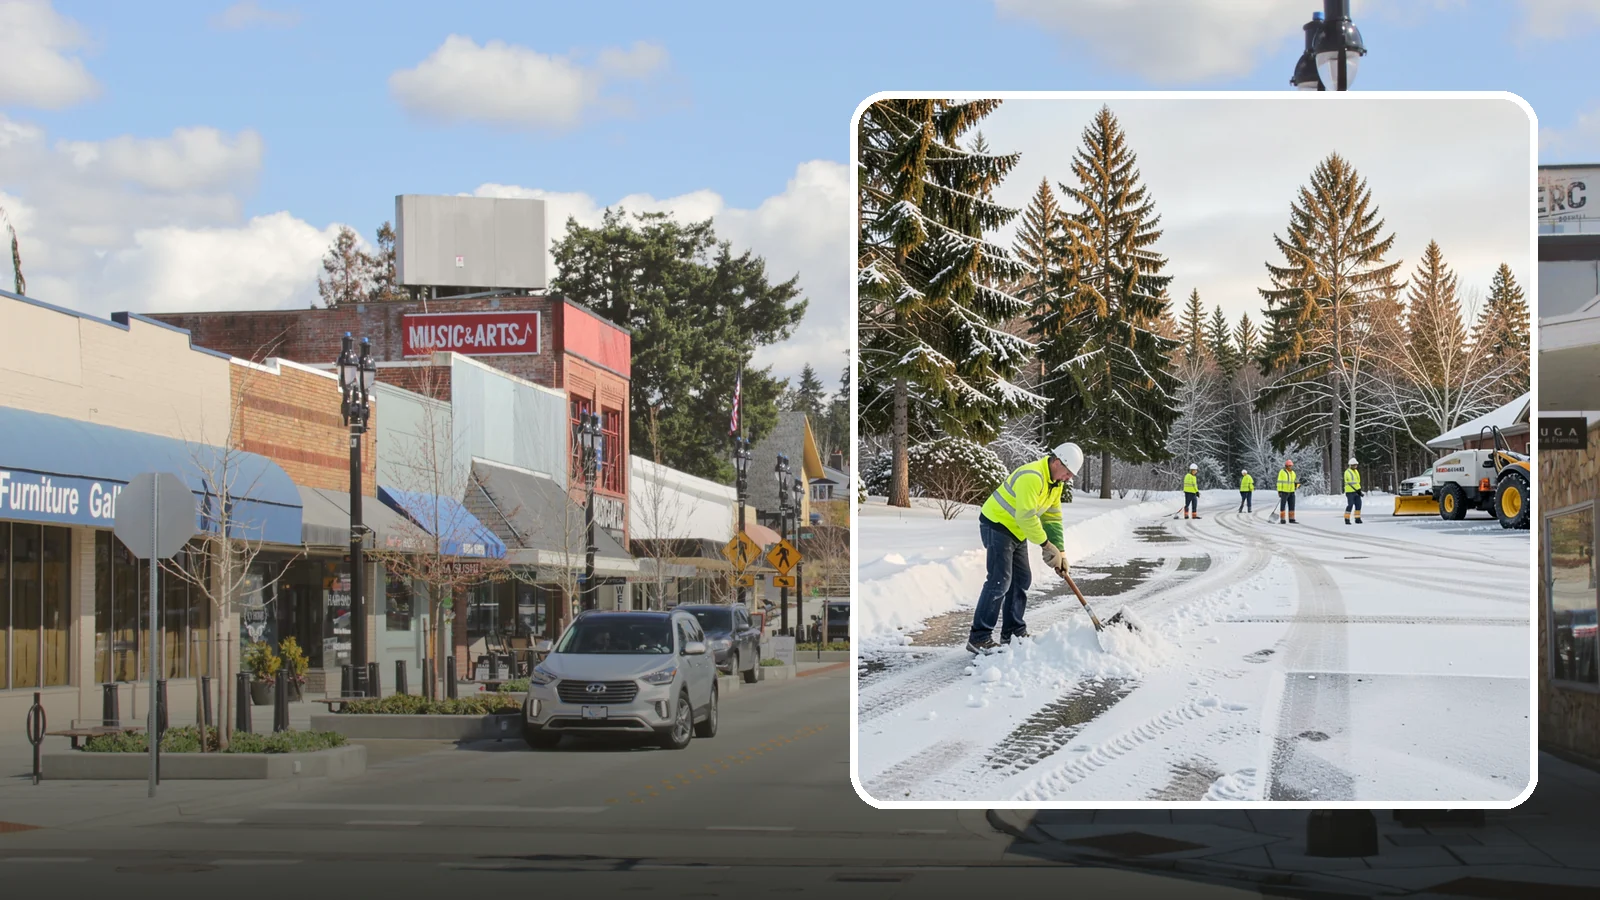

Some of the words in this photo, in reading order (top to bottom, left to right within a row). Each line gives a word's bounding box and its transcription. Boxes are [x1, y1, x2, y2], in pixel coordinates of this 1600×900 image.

[409, 323, 519, 348] MUSIC&ARTS
[1540, 427, 1577, 437] UGA
[0, 471, 79, 515] Furniture
[90, 483, 121, 519] Gal
